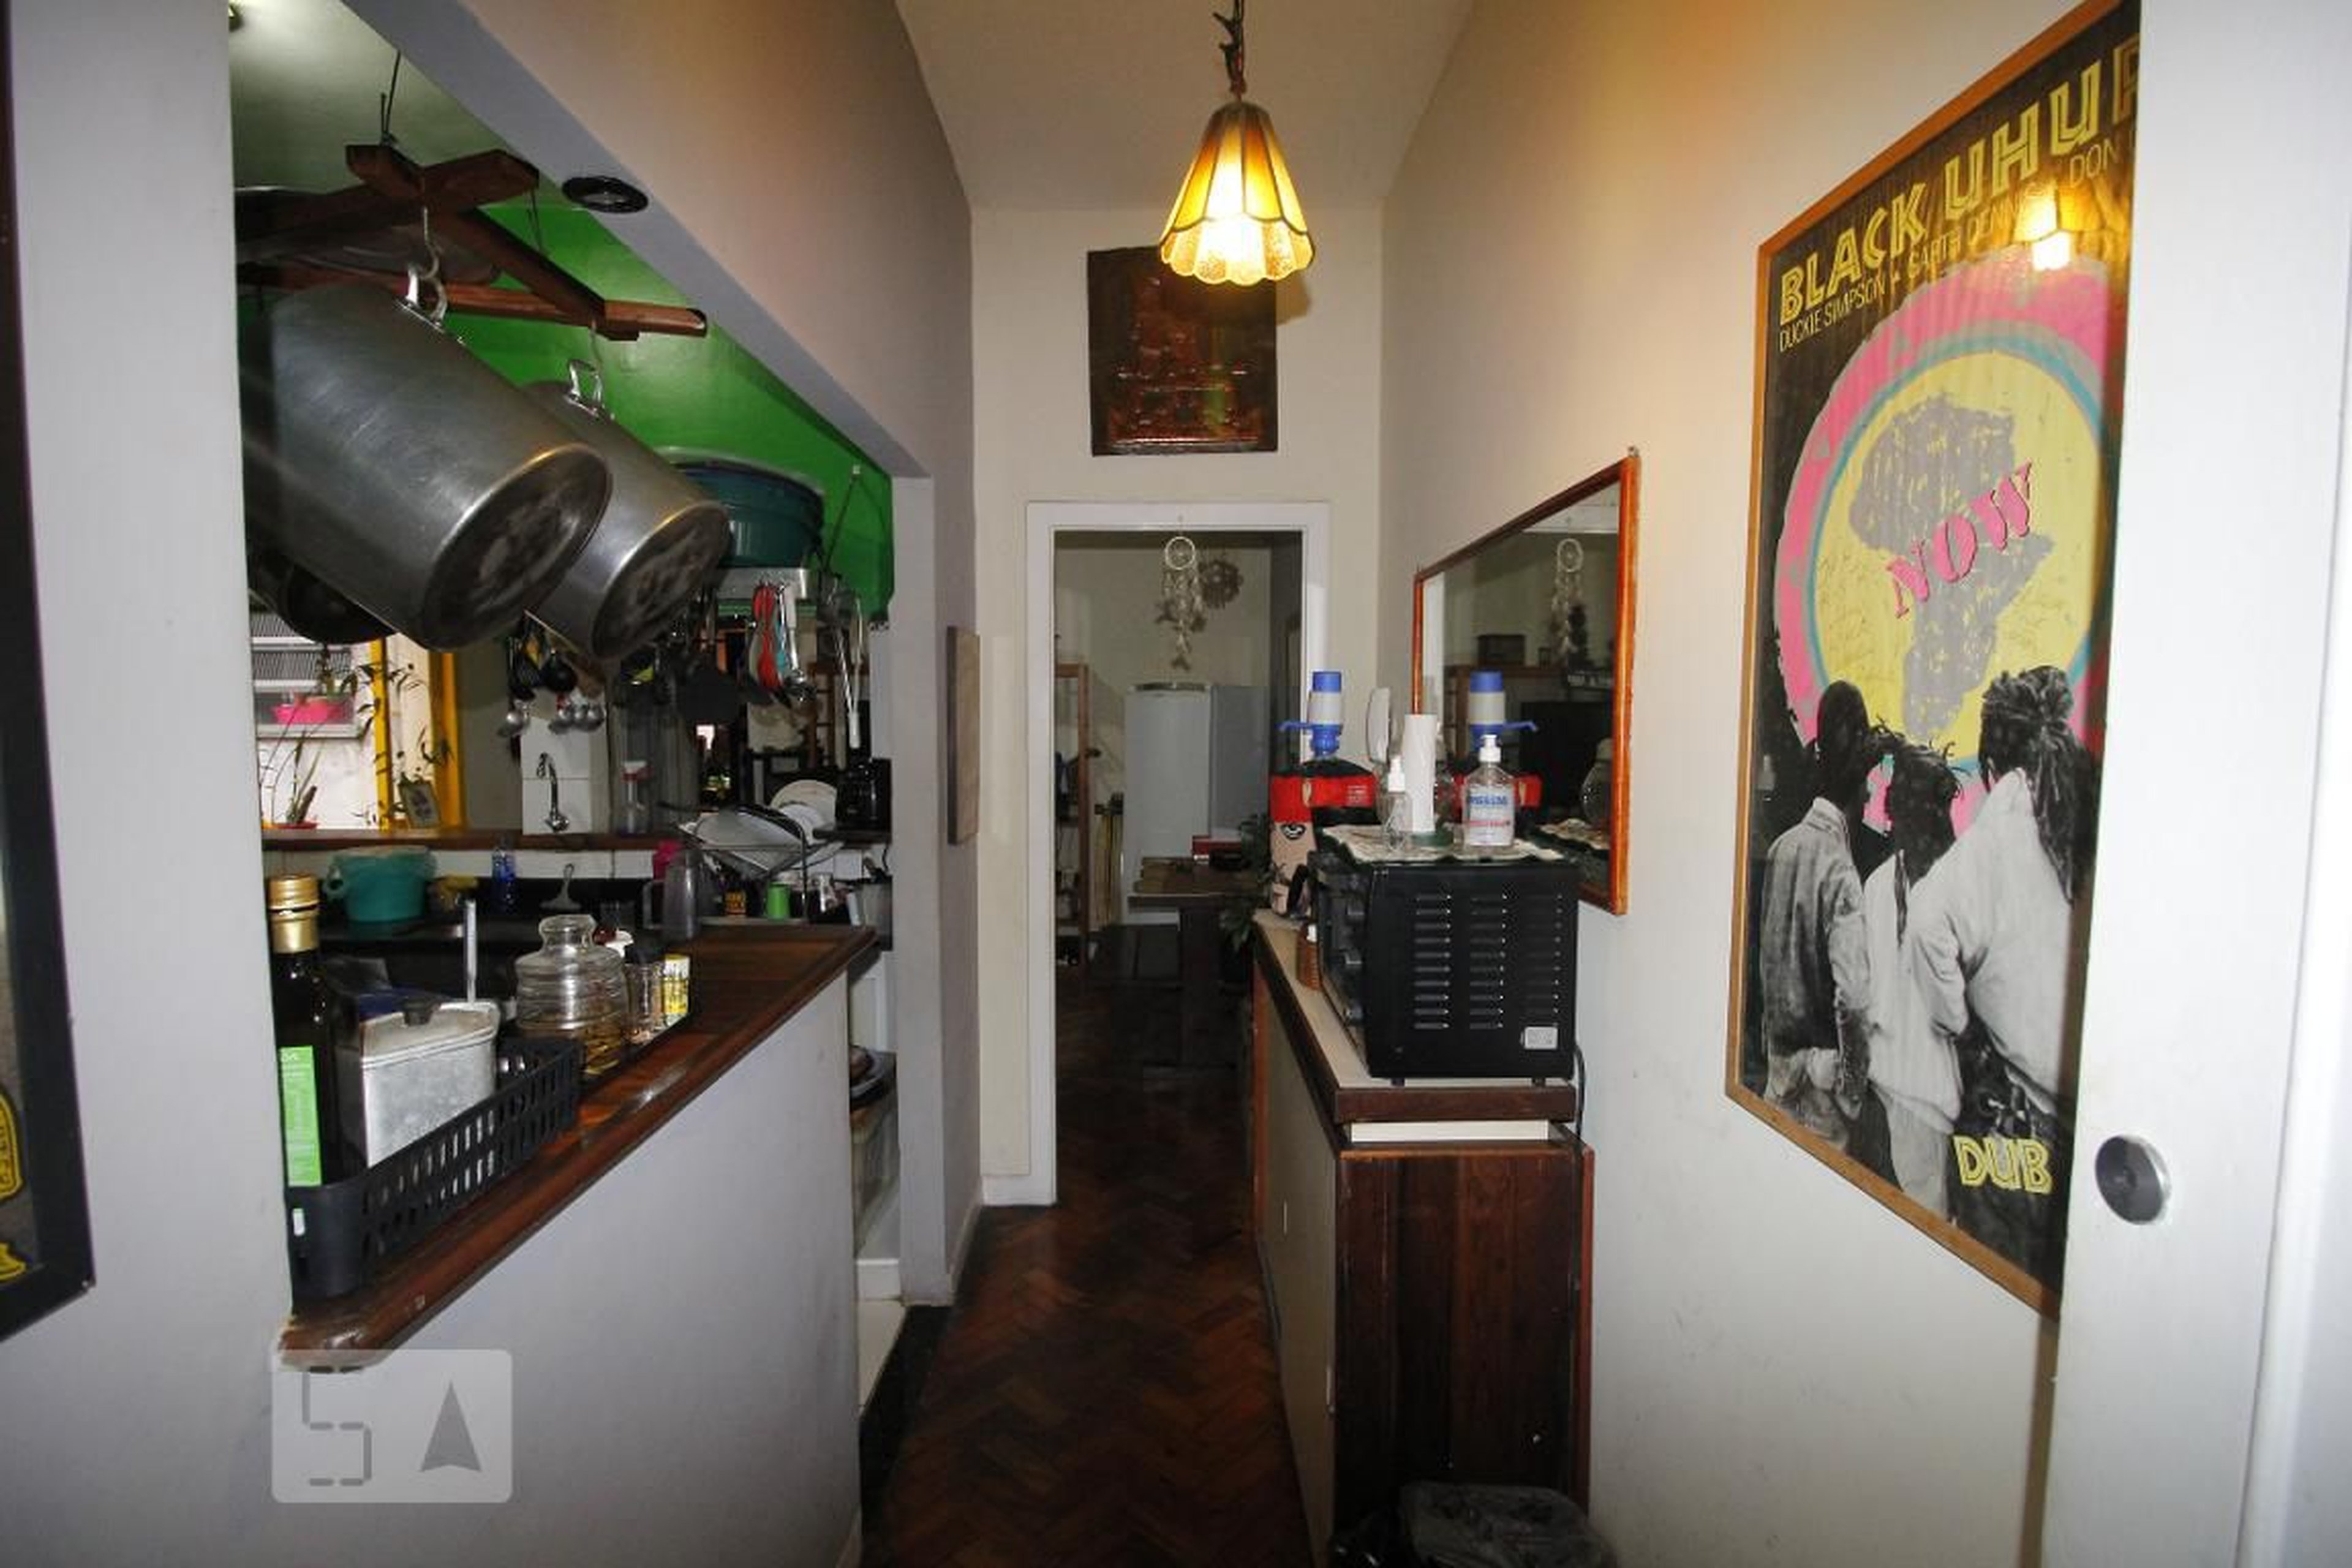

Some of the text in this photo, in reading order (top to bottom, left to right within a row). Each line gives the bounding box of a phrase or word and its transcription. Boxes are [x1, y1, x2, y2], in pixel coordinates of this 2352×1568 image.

[1779, 183, 1926, 326] BLACK
[1886, 458, 2032, 619] NOW
[1953, 1136, 2052, 1195] DUB
